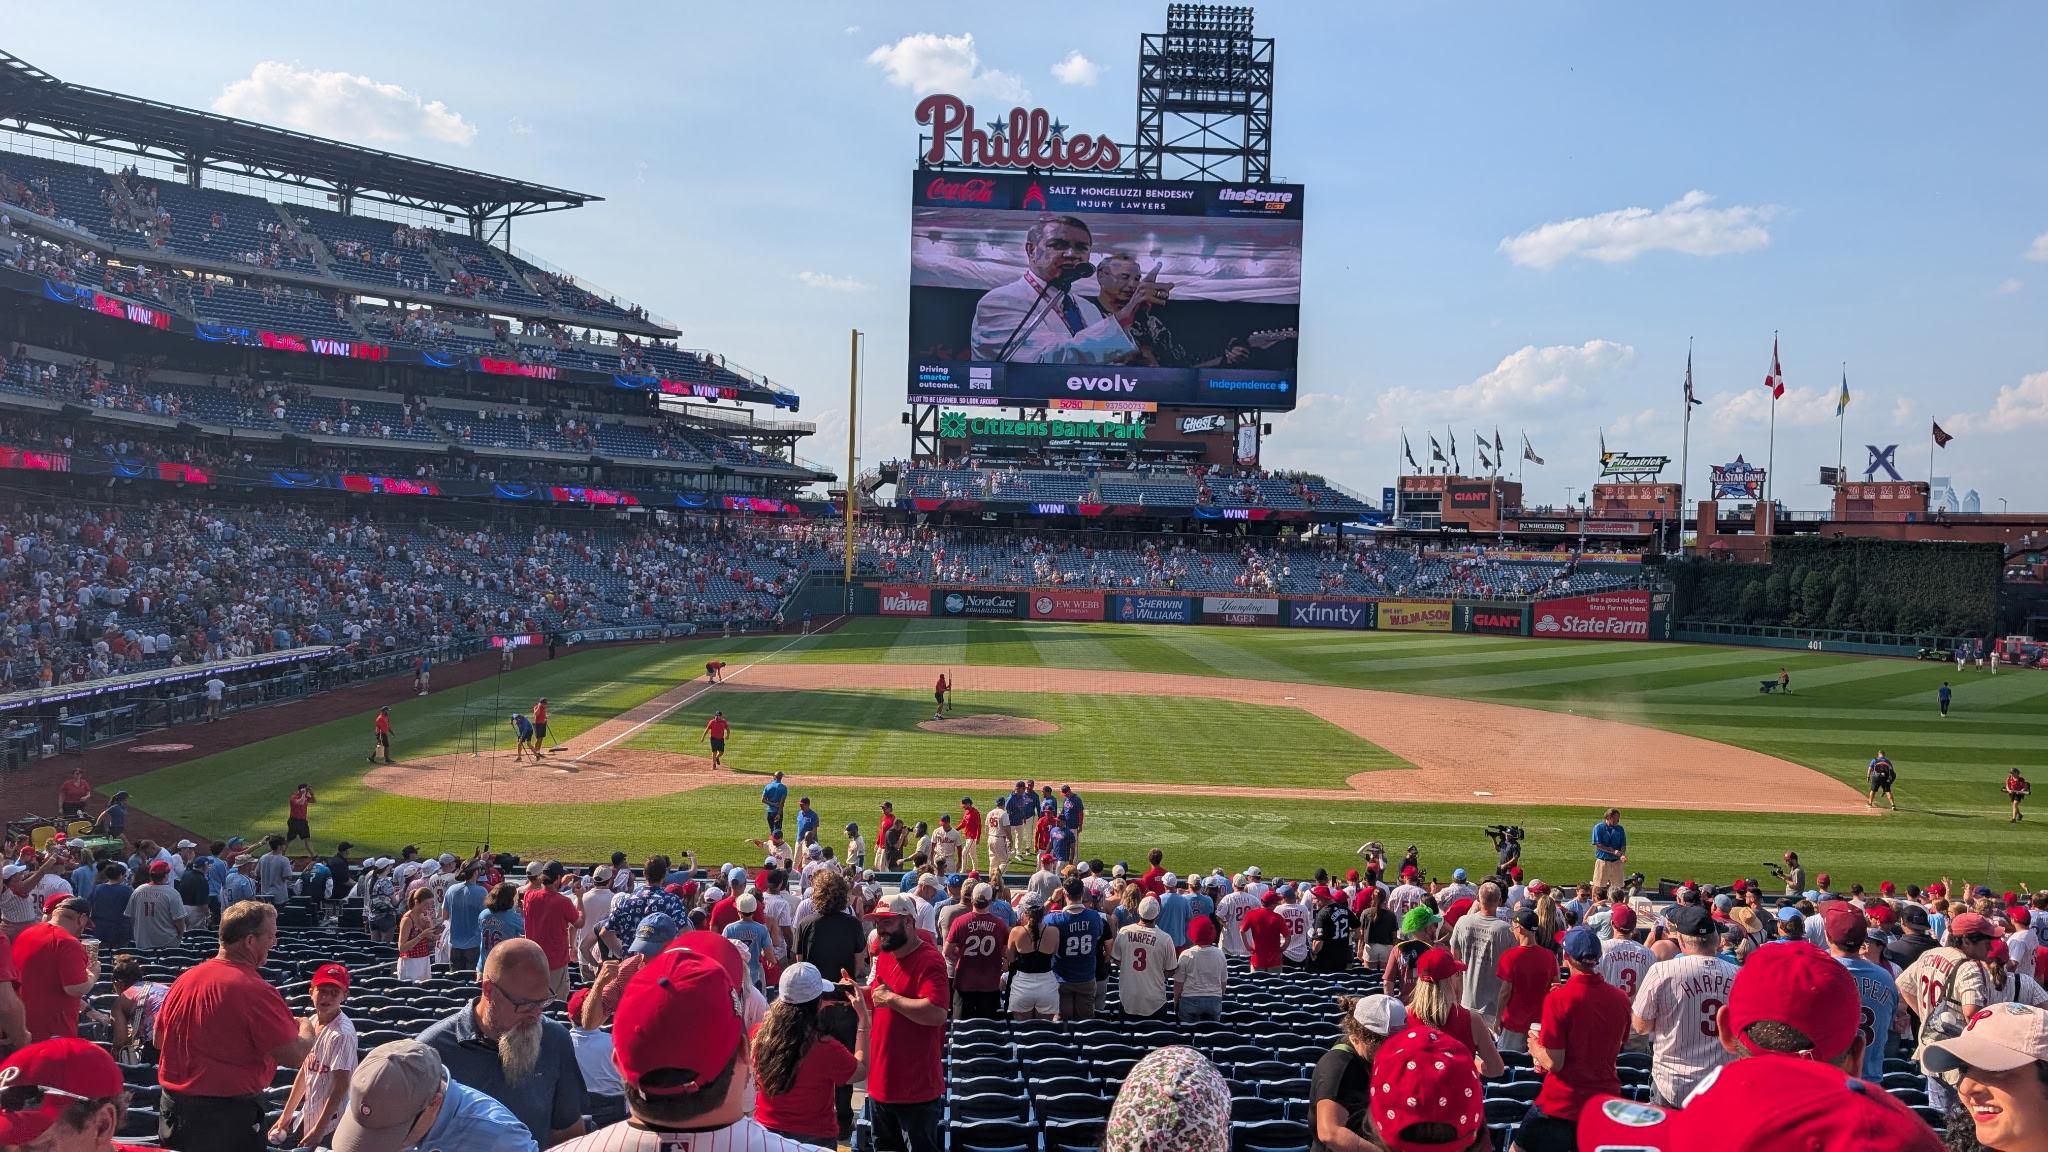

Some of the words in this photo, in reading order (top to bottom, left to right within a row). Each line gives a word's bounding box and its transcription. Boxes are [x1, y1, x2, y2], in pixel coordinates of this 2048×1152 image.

[915, 94, 1120, 170] Phillies
[927, 177, 996, 202] Coca-Cola
[1049, 186, 1077, 195] SALTZ
[1081, 187, 1141, 197] MONGELUZZI
[1146, 189, 1194, 199] BENDESKY
[1219, 188, 1293, 202] theScore
[1077, 200, 1113, 208] INJURY
[1121, 202, 1166, 210] LAWYERS
[311, 339, 350, 357] WIN!
[920, 365, 949, 375] Driving
[919, 381, 960, 389] outcomes.
[1066, 374, 1138, 392] evolv
[1209, 379, 1276, 390] Independence
[692, 384, 719, 398] WIN!
[971, 417, 1048, 436] Citizens
[1051, 419, 1100, 438] Bank
[1104, 420, 1146, 439] Park
[1183, 415, 1217, 433] GHOST
[1609, 453, 1662, 467] Fitzpatrick
[1744, 472, 1765, 482] GAME
[1455, 492, 1488, 501] GIANT
[1038, 503, 1065, 514] WIN!
[1223, 509, 1249, 520] WIN!
[884, 597, 927, 611] Wawa
[965, 596, 1016, 608] NovaCare
[1073, 601, 1100, 609] WEBB
[1137, 597, 1183, 609] SHERWIN
[1217, 600, 1265, 613] Yuengling
[1605, 597, 1619, 605] good
[1225, 614, 1256, 623] LAGER
[1295, 602, 1361, 625] xfinity
[1473, 614, 1521, 627] GIANT
[514, 636, 531, 645] WIN!
[1808, 641, 1823, 650] 401
[144, 902, 155, 917] 11
[967, 921, 997, 933] SCHMIDT
[1069, 920, 1090, 932] UTLEY
[1333, 918, 1349, 939] 12
[1066, 934, 1092, 956] 26
[1127, 931, 1157, 946] HARPER
[963, 935, 996, 956] 20
[1132, 947, 1147, 972] 3
[1609, 951, 1647, 965] HARPER
[1619, 968, 1637, 998] 3
[1681, 974, 1733, 999] HARPE
